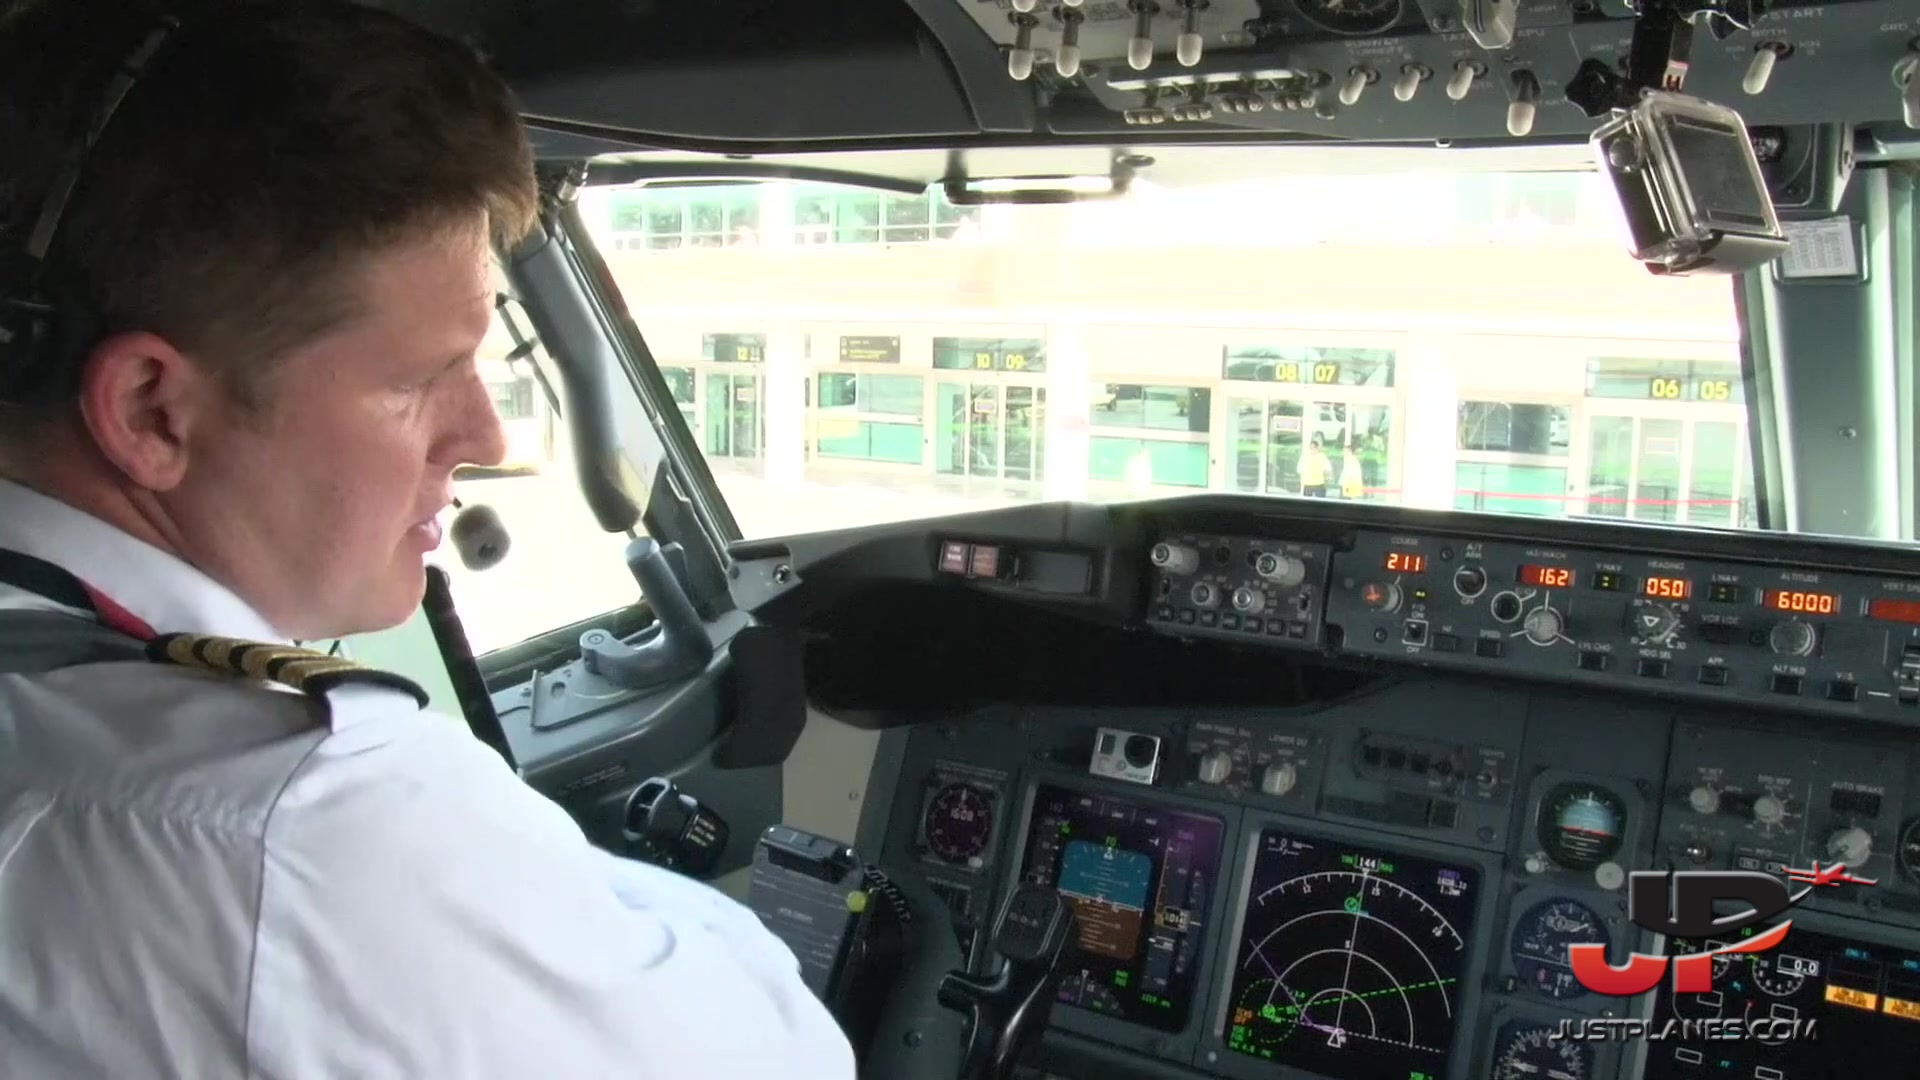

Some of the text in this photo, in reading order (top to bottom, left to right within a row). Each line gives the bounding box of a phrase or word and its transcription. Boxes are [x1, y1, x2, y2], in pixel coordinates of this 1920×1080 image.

[975, 353, 990, 368] 10
[1006, 354, 1025, 369] 09
[1275, 363, 1297, 381] 08
[1315, 364, 1336, 382] 07
[1652, 379, 1679, 398] 06
[1701, 380, 1729, 400] 05
[1387, 553, 1421, 572] 211
[1648, 561, 1685, 571] HEADING
[1539, 568, 1569, 587] 162
[1781, 573, 1819, 584] ALTITUDE
[1646, 577, 1684, 597] 050
[1778, 591, 1832, 613] 6000
[1359, 857, 1376, 868] 144
[1794, 959, 1817, 974] 0.0
